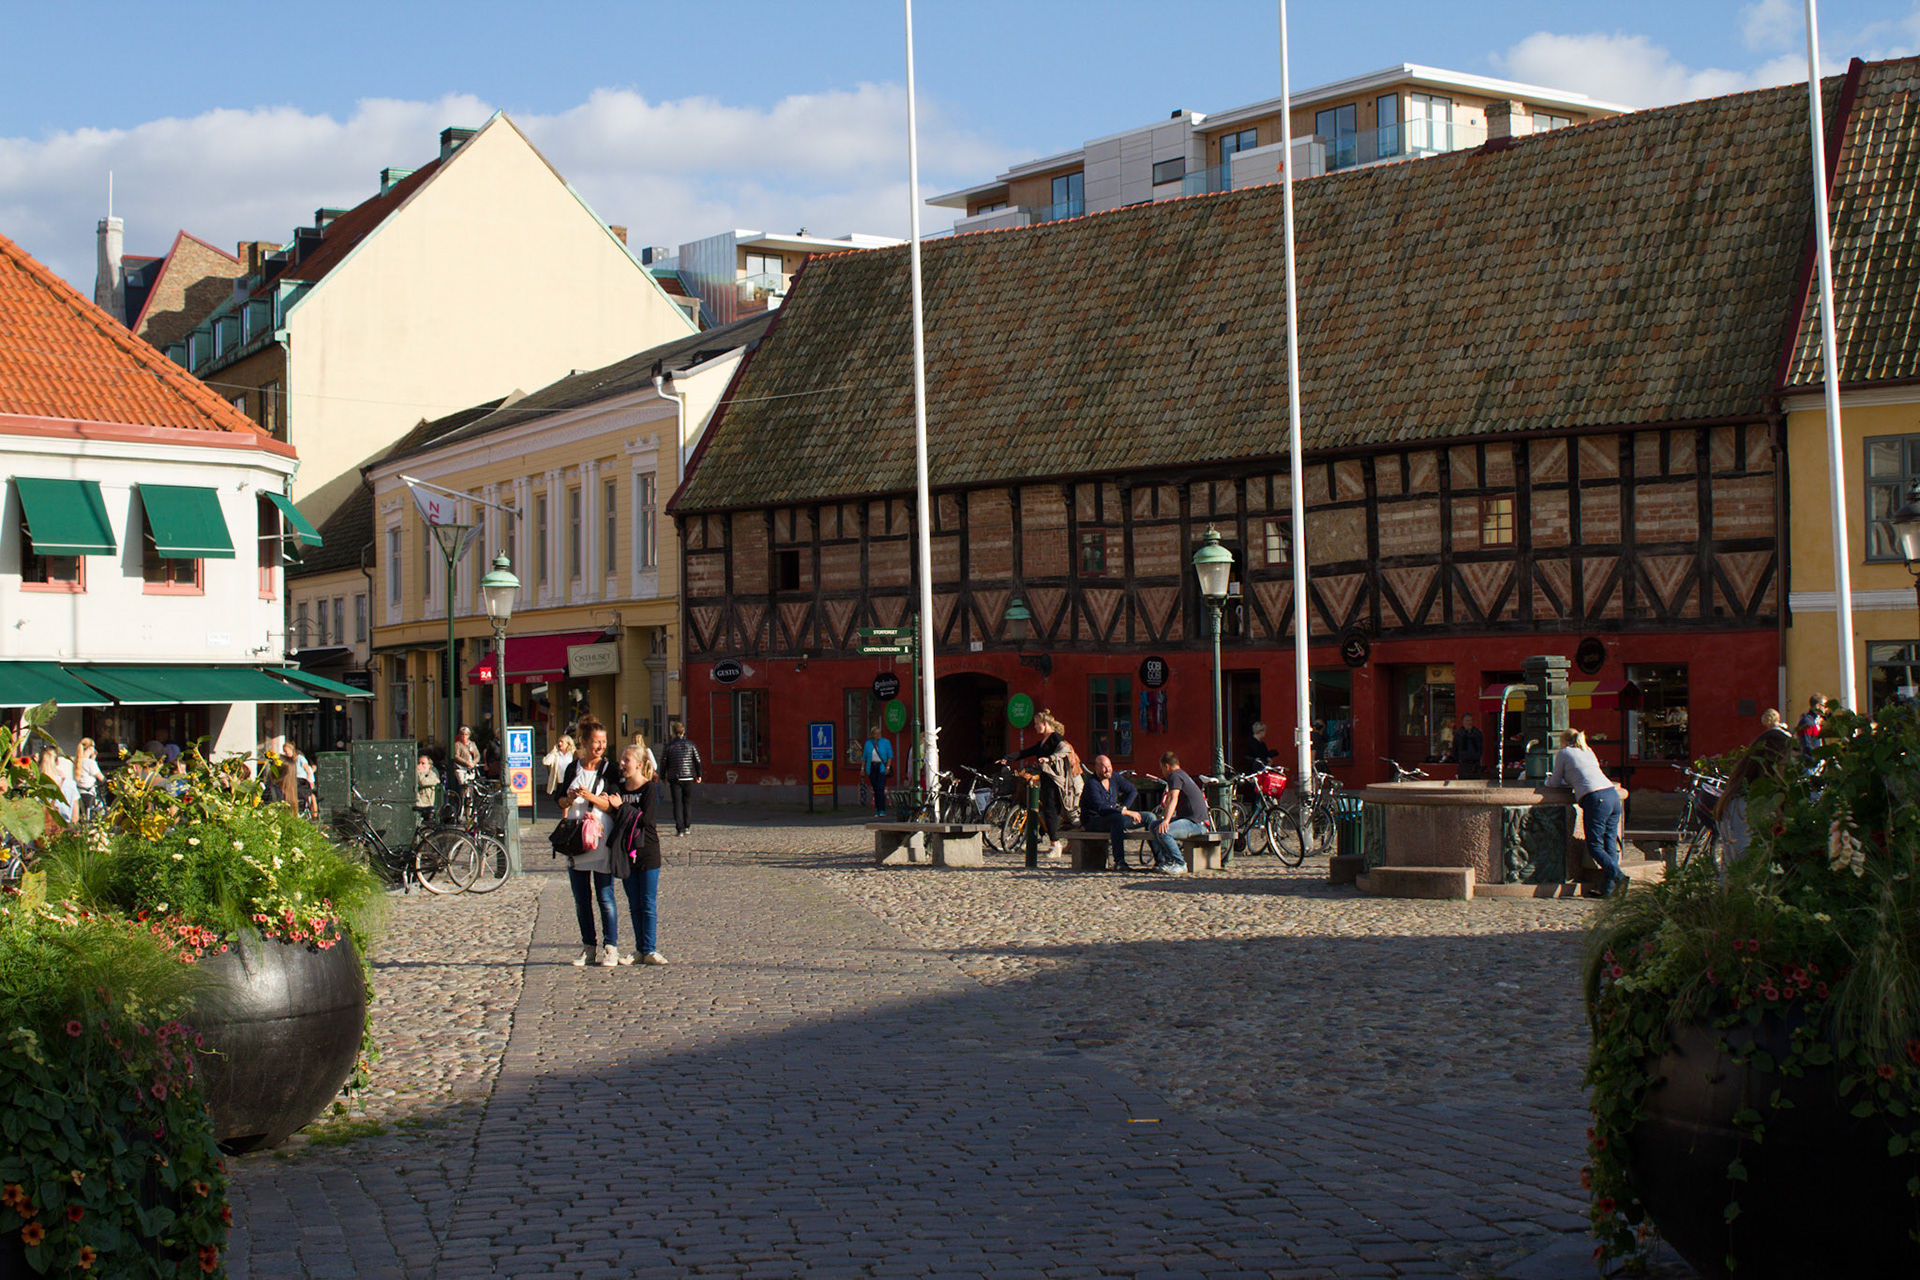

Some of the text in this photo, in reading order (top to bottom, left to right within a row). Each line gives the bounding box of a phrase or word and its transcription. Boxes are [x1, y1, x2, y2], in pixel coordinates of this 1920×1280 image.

[574, 653, 610, 662] OSTHUSET
[1147, 661, 1162, 671] GOBI
[717, 669, 740, 677] GUSTUS
